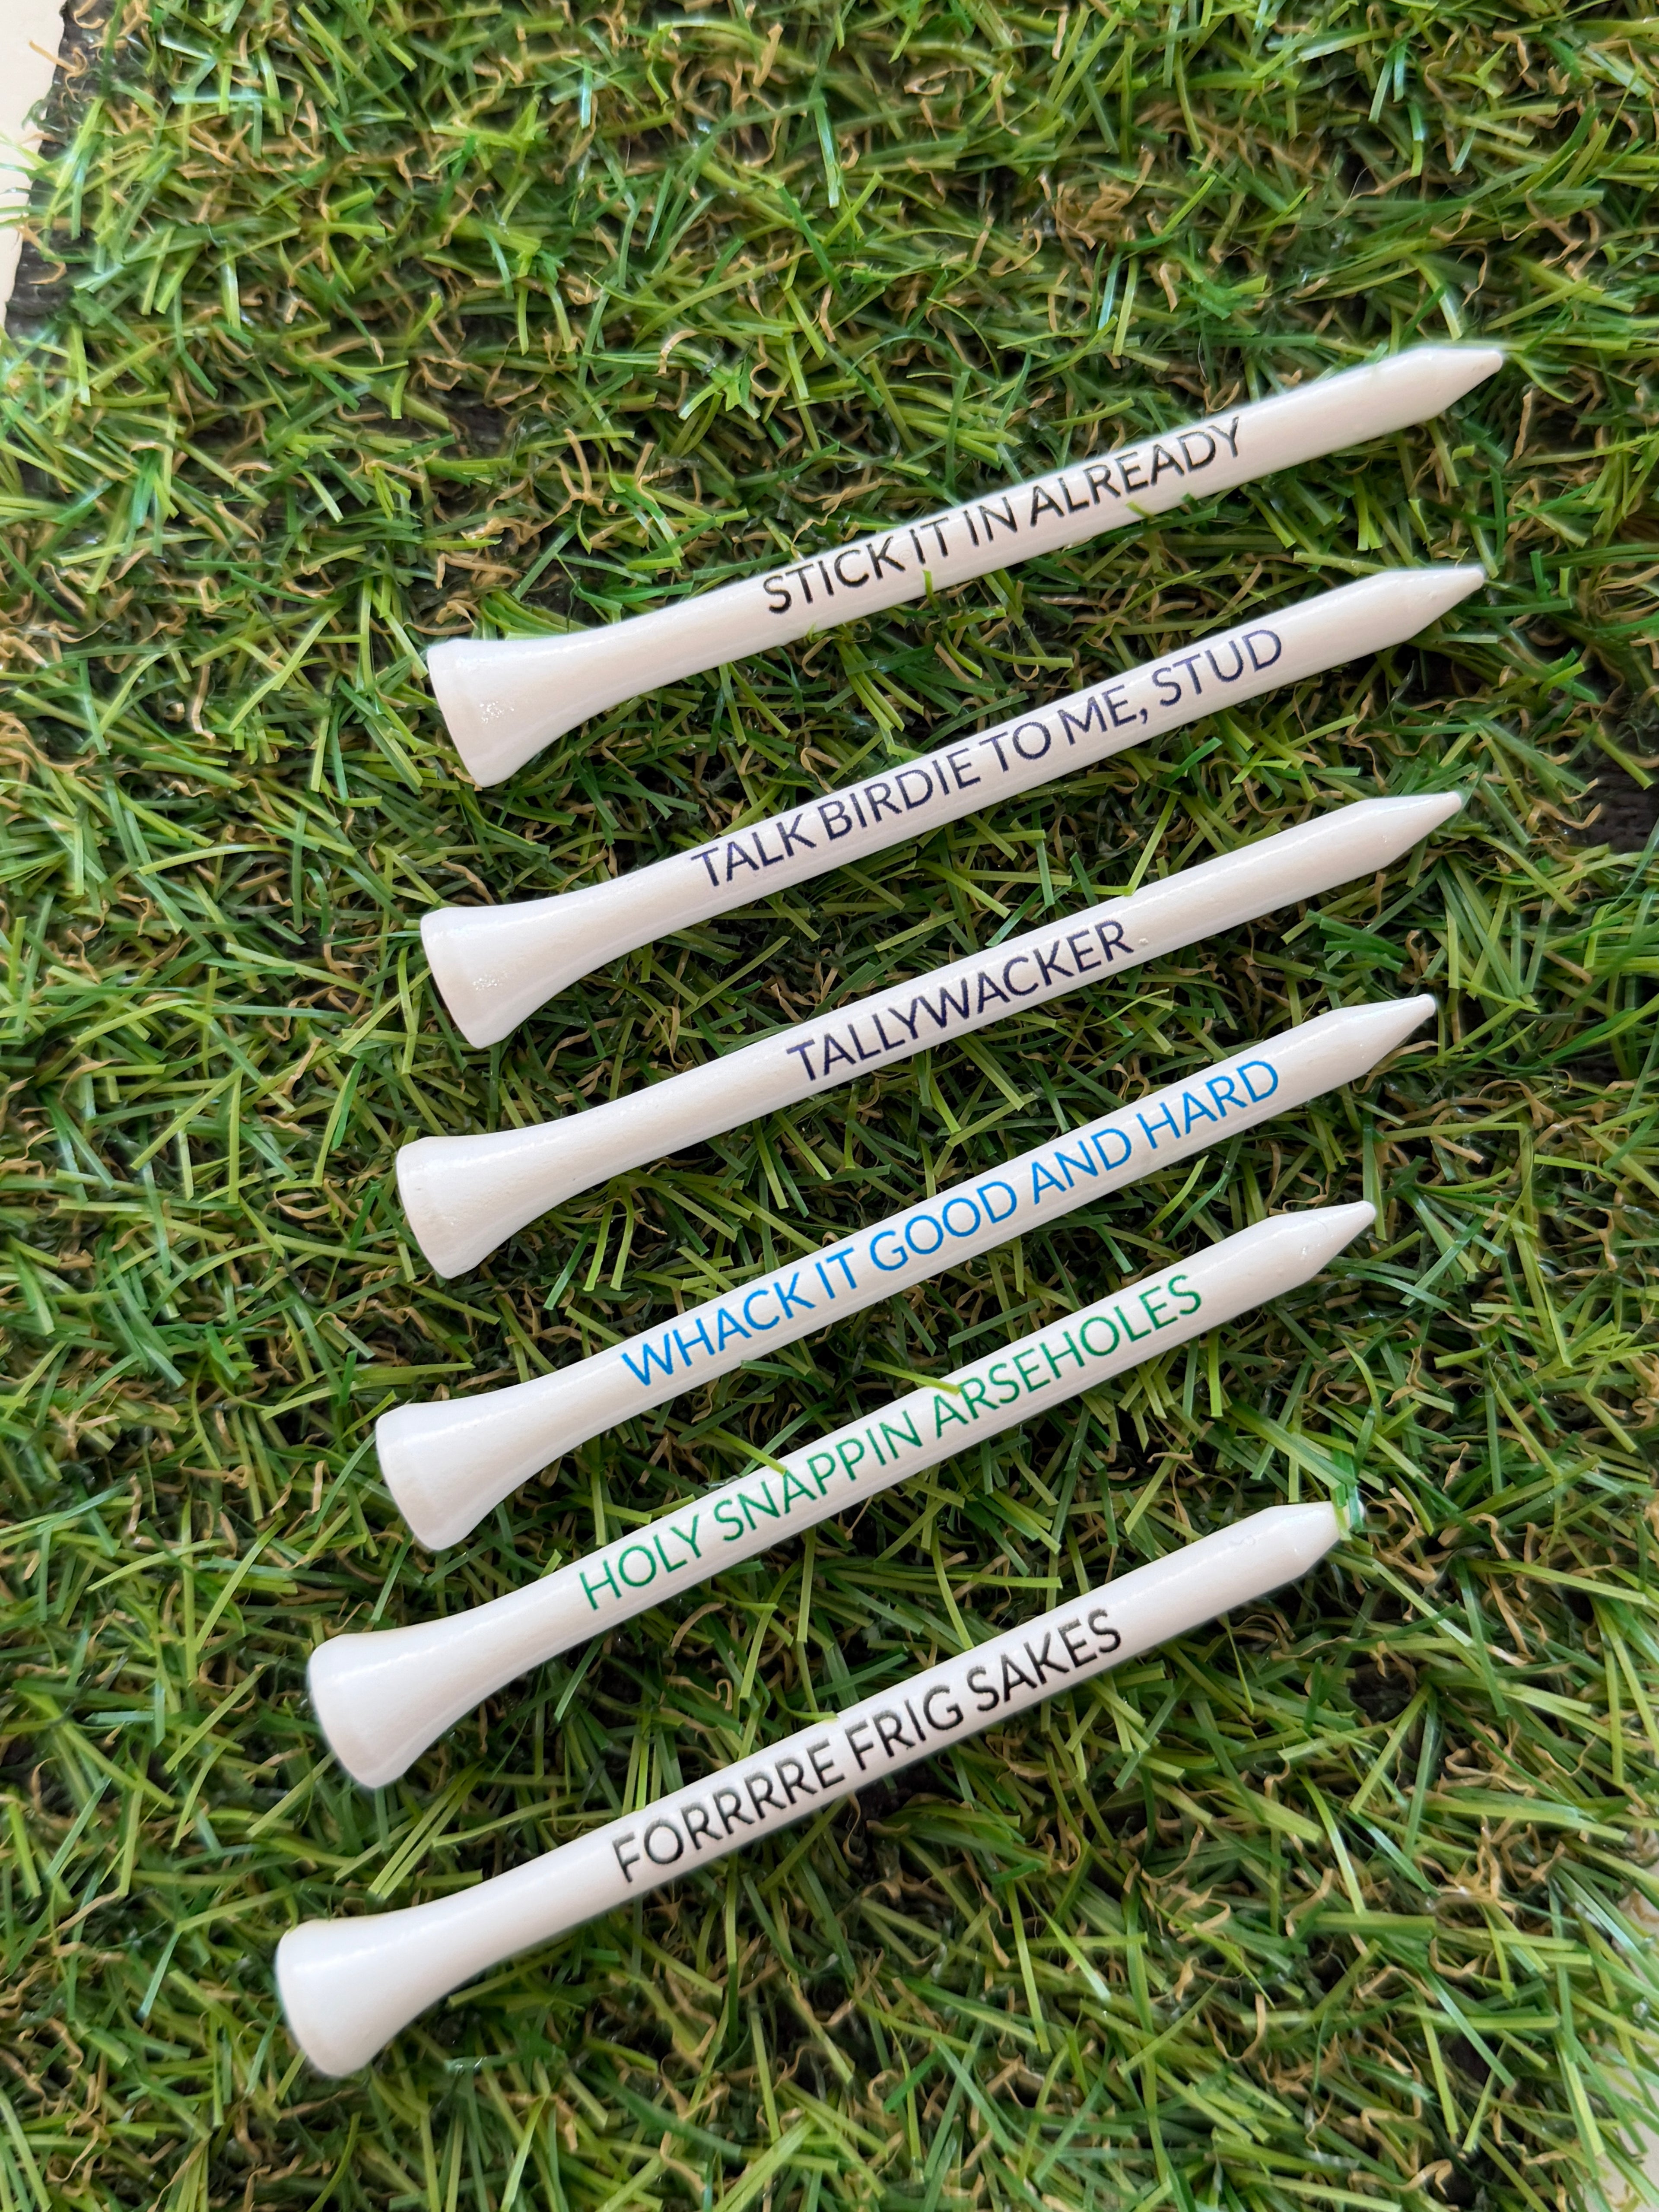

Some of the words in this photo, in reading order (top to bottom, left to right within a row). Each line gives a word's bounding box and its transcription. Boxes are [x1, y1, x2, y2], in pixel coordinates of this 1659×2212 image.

[763, 537, 906, 614] STICK
[910, 517, 949, 564] IT
[965, 497, 1018, 546] IN
[1030, 417, 1240, 527] ALREADY
[691, 815, 817, 887] TALK
[817, 747, 981, 841] BIRDIE
[979, 721, 1051, 772] TO
[1056, 685, 1149, 746] ME,
[1154, 629, 1282, 706] STUD
[787, 920, 1135, 1081] TALLYWACKER
[621, 1273, 816, 1386] WHACK
[816, 1247, 858, 1299] IT
[870, 1181, 1017, 1271] GOOD
[1033, 1128, 1132, 1205] AND
[1141, 1060, 1278, 1149] HARD
[579, 1514, 703, 1611] HOLY
[713, 1410, 923, 1542] SNAPPIN
[933, 1274, 1202, 1439] ARSEHOLES
[612, 1738, 845, 1883] FORRRRE
[845, 1685, 963, 1770] FRIG
[967, 1608, 1121, 1713] SAKES
